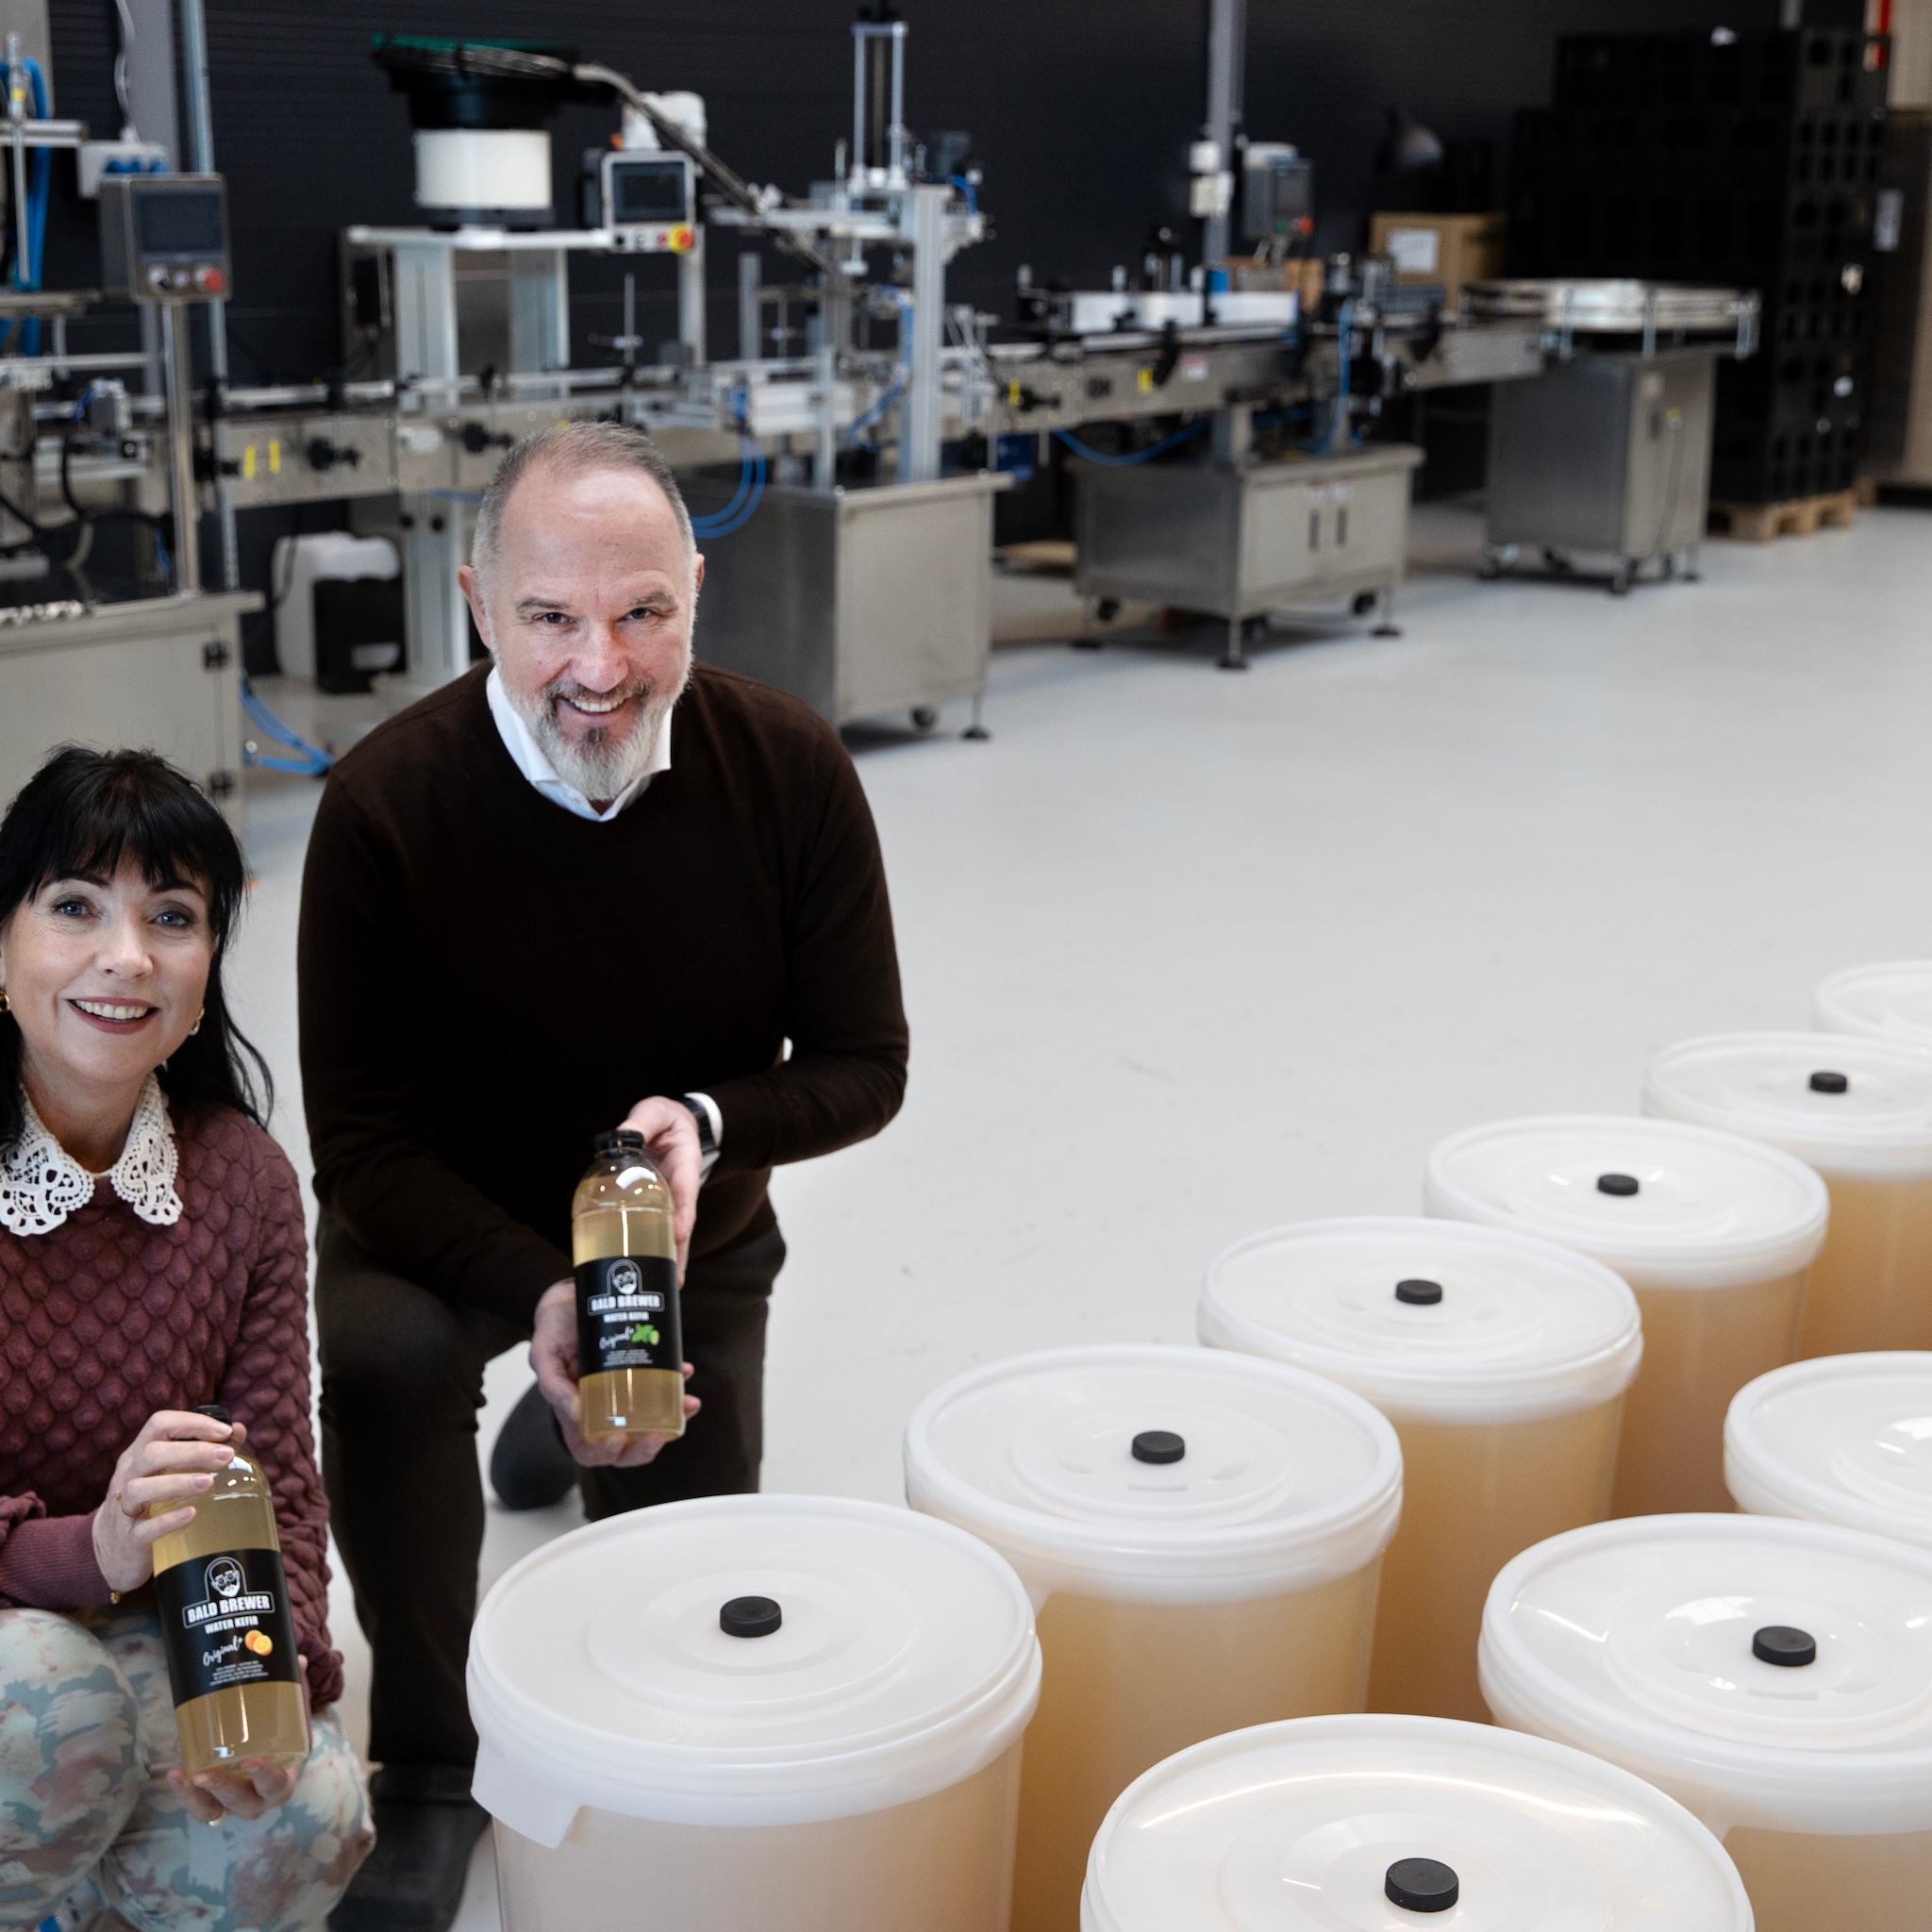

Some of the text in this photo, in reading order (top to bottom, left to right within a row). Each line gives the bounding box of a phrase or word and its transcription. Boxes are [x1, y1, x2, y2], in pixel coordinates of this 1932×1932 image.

[187, 1595, 270, 1624] BALD BREWER
[205, 1615, 258, 1635] WATER KEFIR
